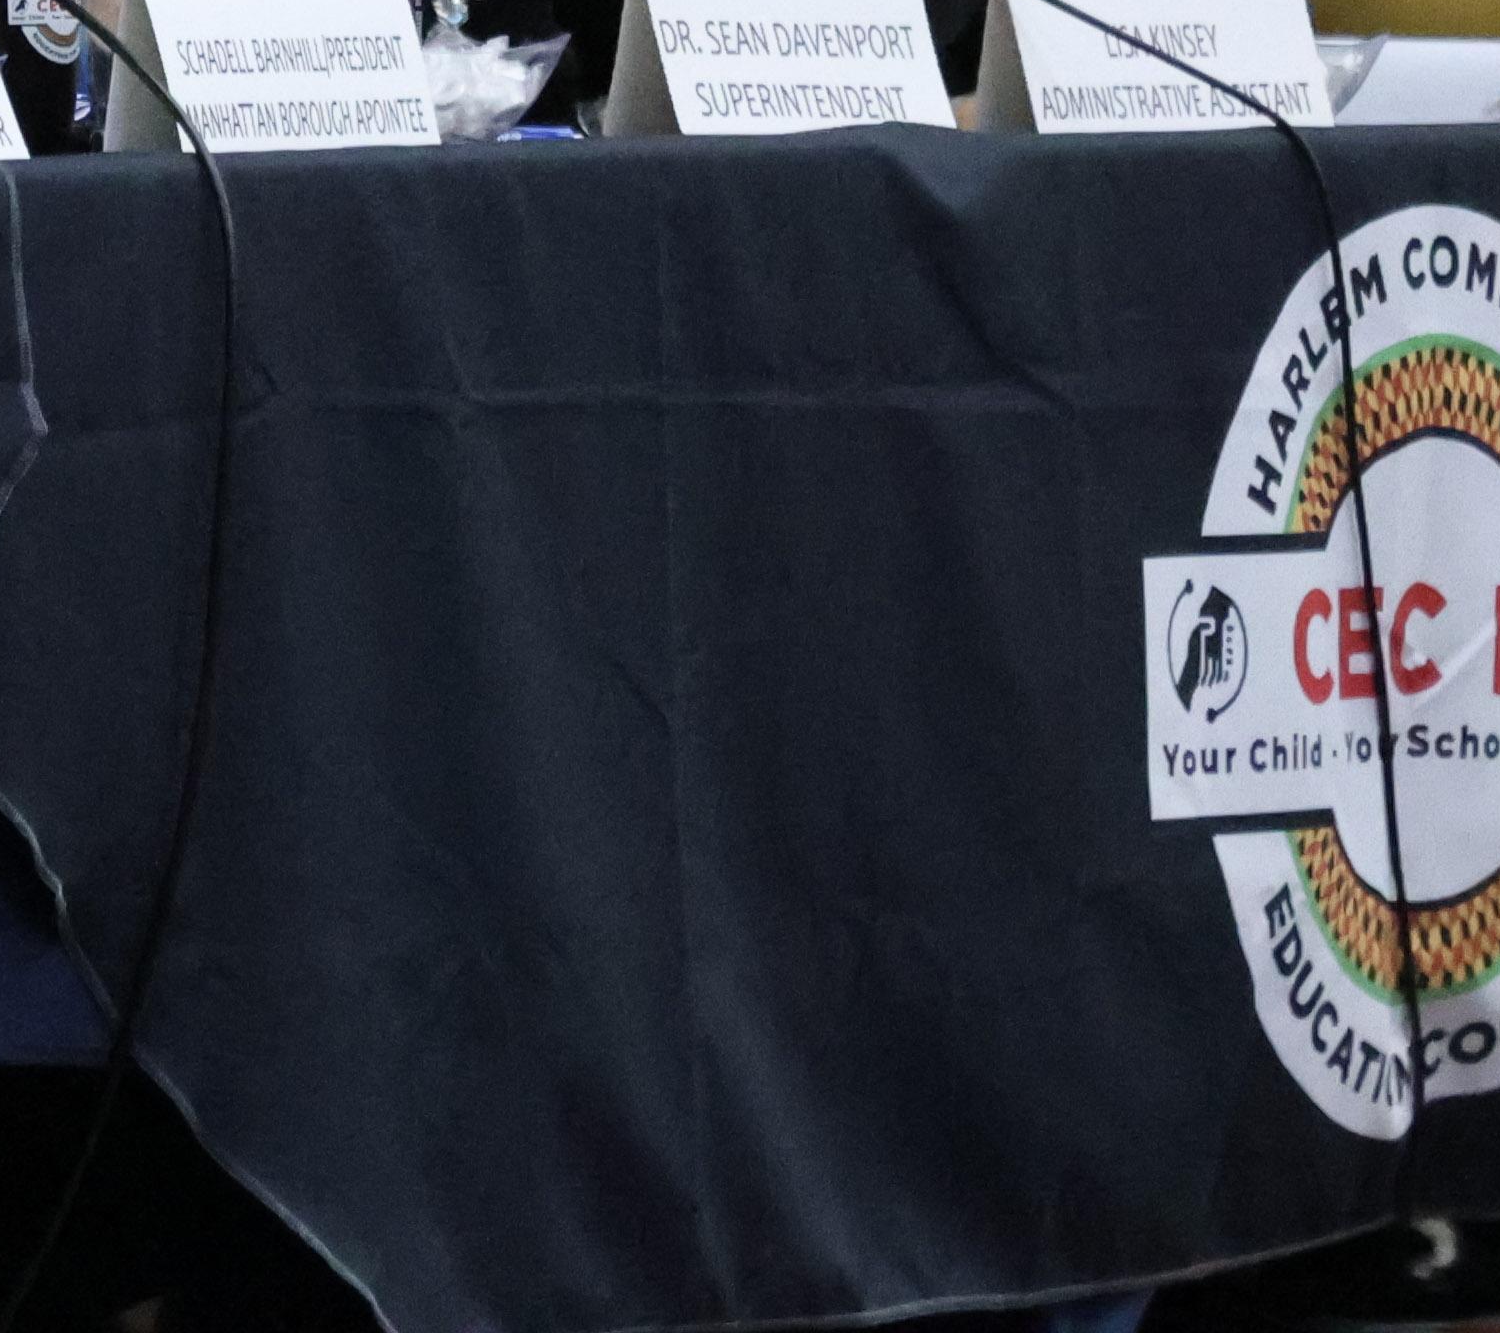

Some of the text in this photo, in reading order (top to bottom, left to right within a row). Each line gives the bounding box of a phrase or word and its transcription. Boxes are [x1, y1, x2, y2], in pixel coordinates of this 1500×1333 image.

[176, 39, 254, 76] SCHADELL
[659, 20, 915, 60] DR. SEAN DAVENPORT
[1148, 24, 1218, 57] KINSEY
[185, 97, 428, 140] MANHATTAN BOROUGH APOINTEE
[695, 82, 907, 121] SUPERINTENDENT
[1043, 83, 1311, 120] ADMINISTRATIVE ASSISTANT
[1247, 253, 1388, 516] HARLEM
[1293, 580, 1447, 705] CEC
[1163, 742, 1236, 777] Your
[1249, 734, 1323, 772] Child
[1263, 882, 1413, 1106] EDUCATIN
